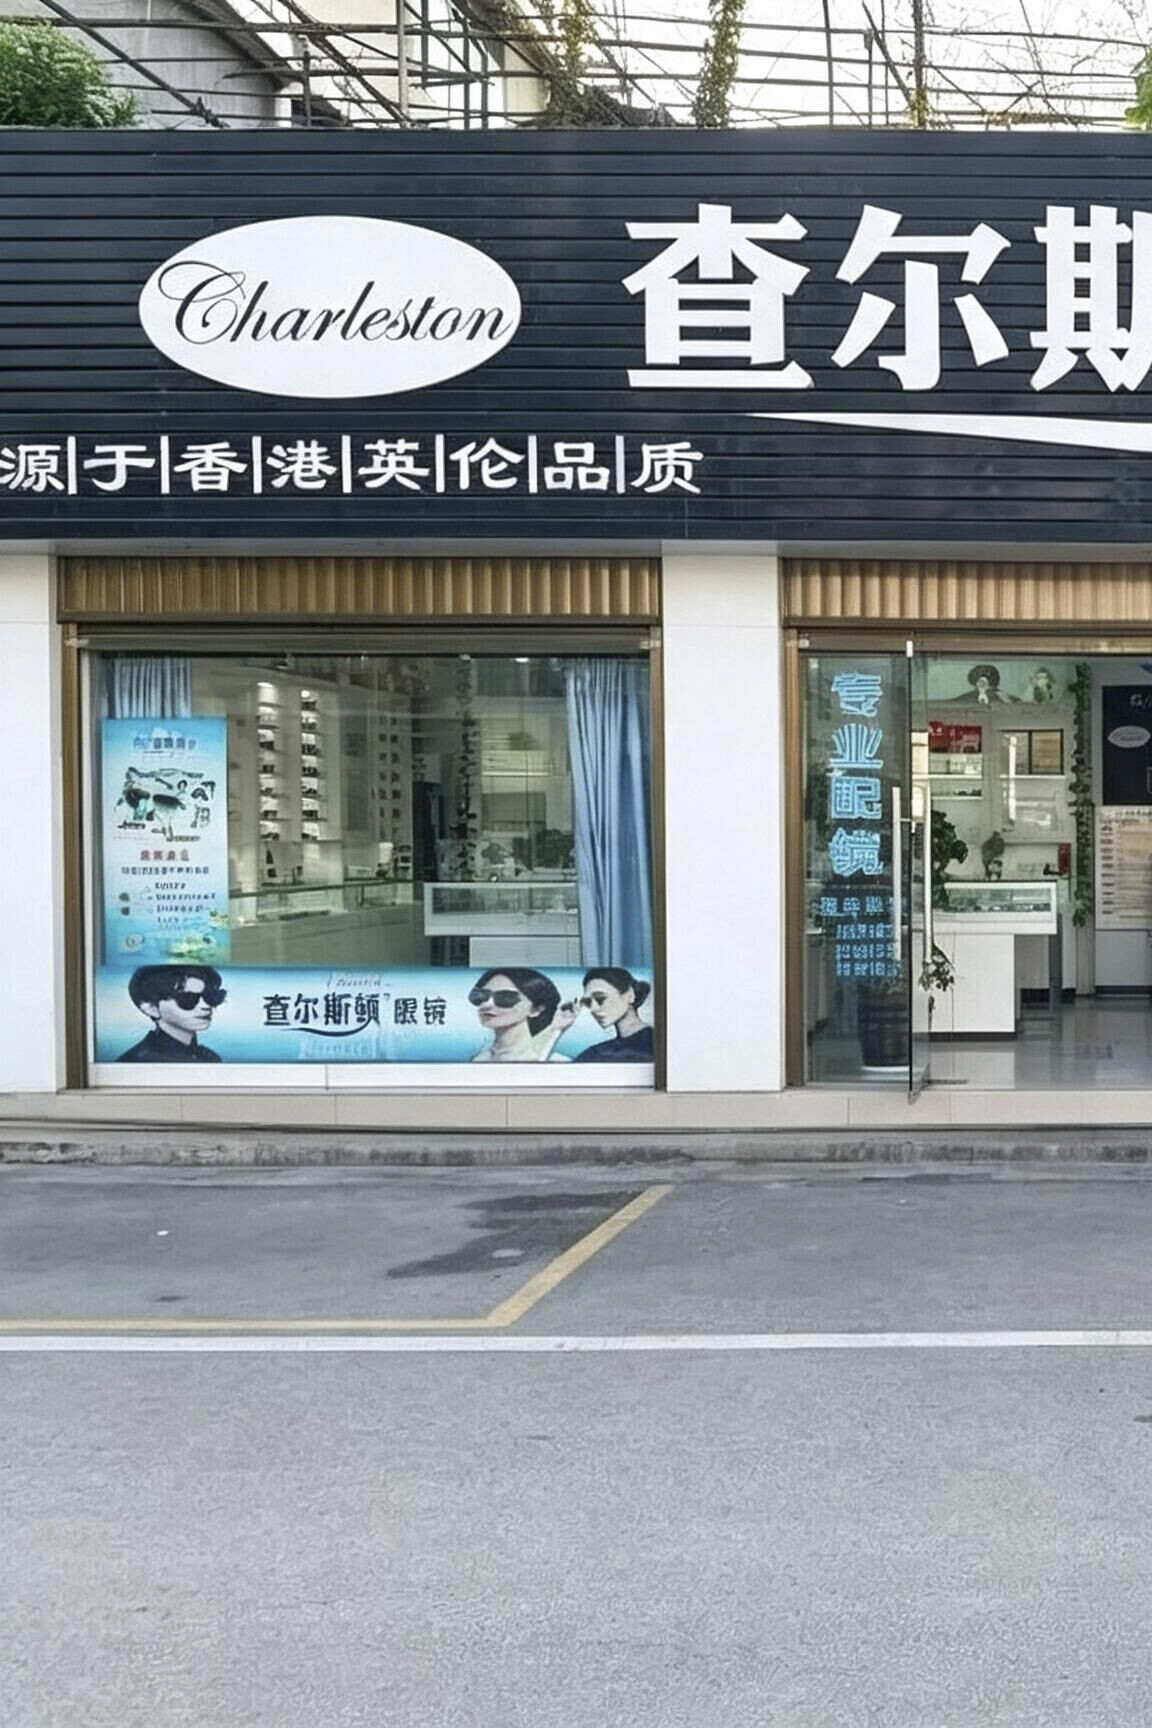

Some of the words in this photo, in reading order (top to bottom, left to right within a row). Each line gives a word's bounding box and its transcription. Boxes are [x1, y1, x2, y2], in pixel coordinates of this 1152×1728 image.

[157, 260, 516, 345] Charleston
[263, 992, 383, 1026] 查尔斯顿
